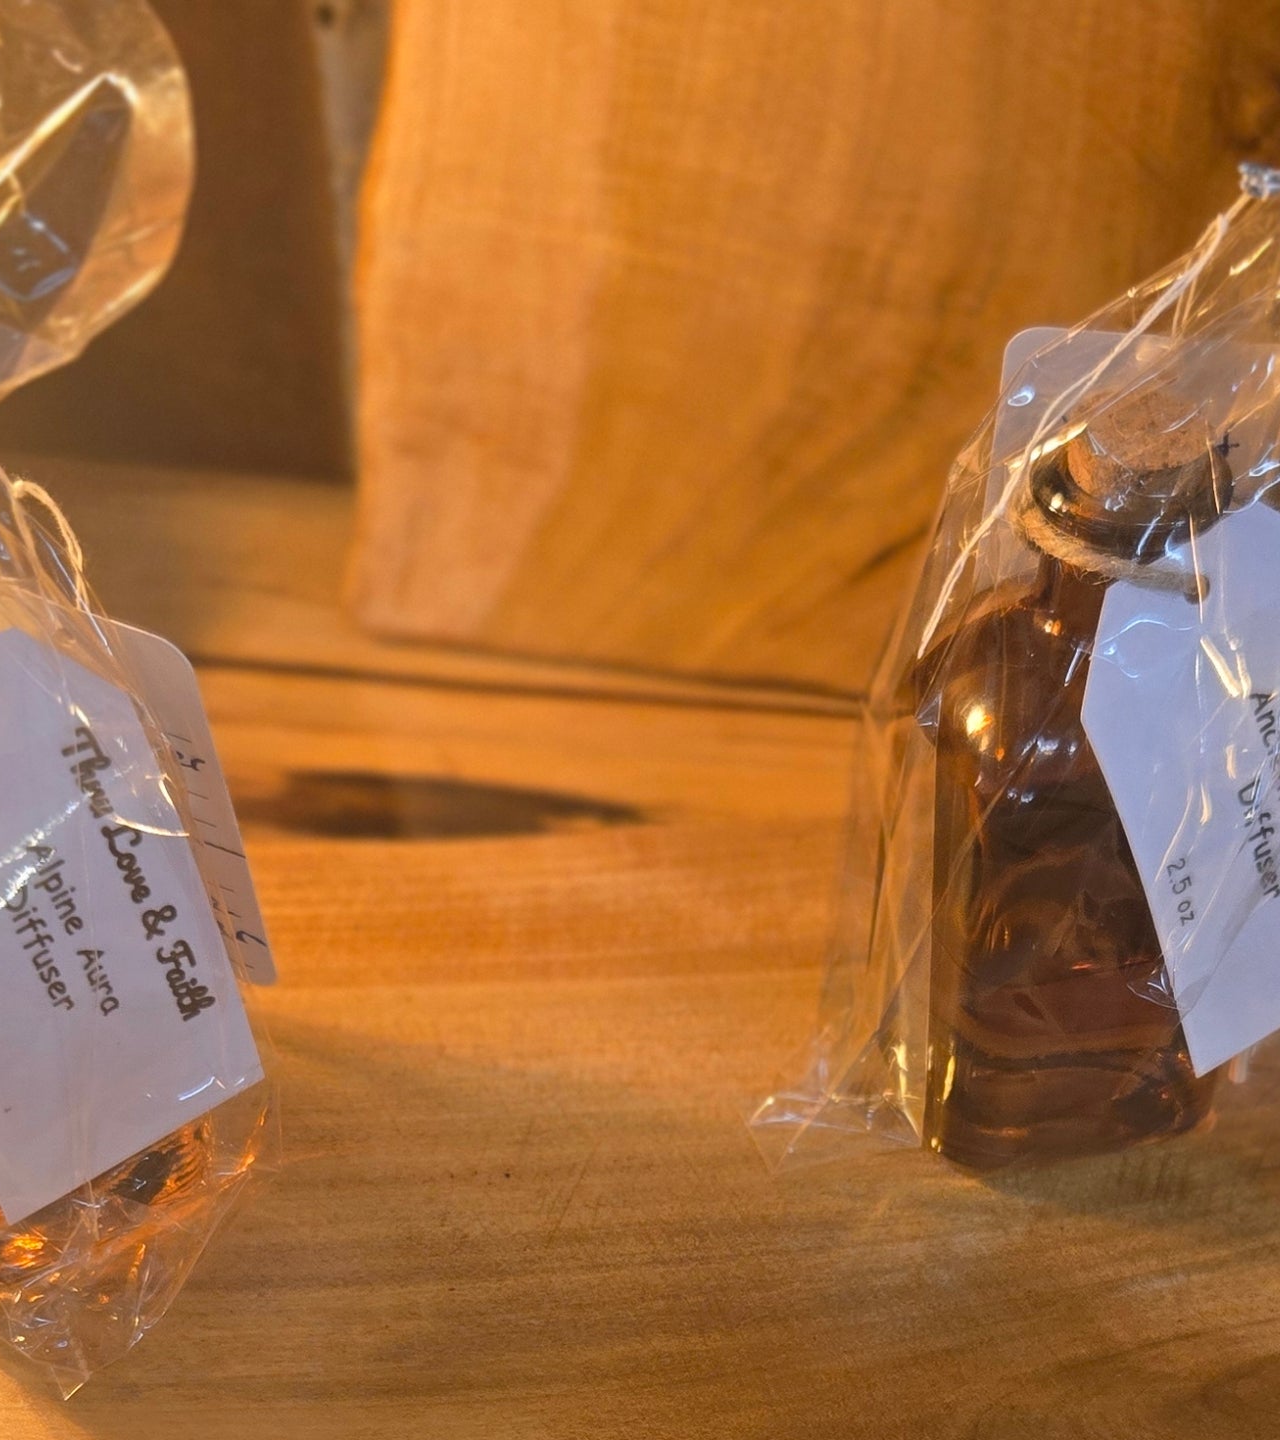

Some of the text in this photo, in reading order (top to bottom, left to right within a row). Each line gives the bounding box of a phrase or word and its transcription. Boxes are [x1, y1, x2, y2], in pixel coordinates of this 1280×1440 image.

[100, 824, 151, 904] Love
[1166, 857, 1195, 927] 2.5 oz
[3, 880, 75, 1011] Diffuser
[23, 846, 120, 1017] Alpine Aura
[141, 904, 178, 941] &
[156, 939, 217, 1022] Faith
